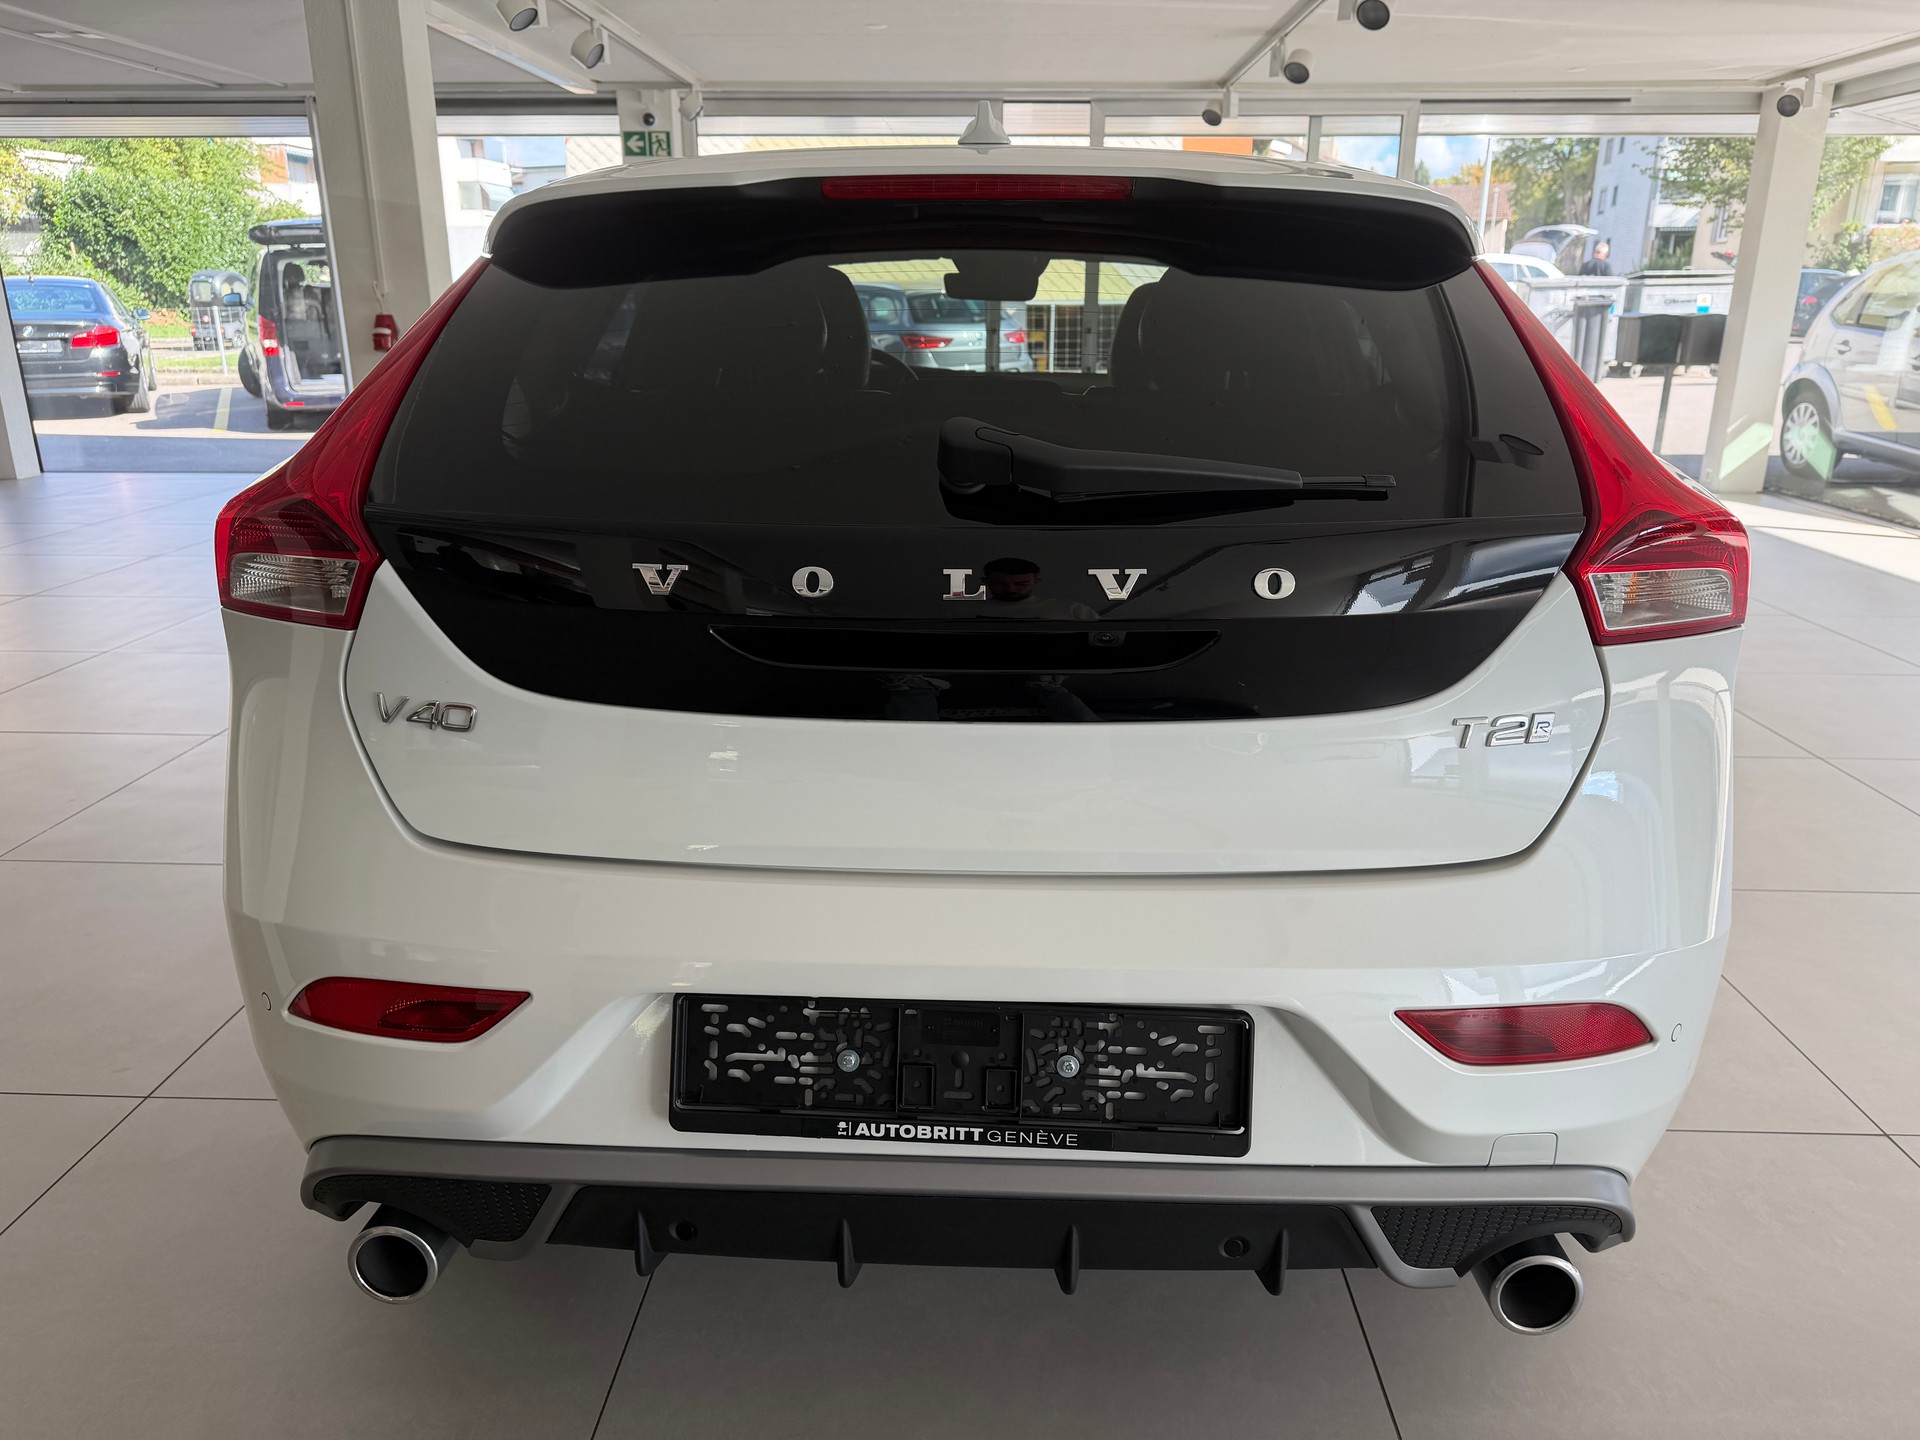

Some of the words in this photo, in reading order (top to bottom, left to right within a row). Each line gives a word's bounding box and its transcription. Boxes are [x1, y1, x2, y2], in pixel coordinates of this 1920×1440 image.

[631, 563, 1296, 601] VOLVO
[376, 692, 477, 732] V40
[1452, 714, 1528, 748] T2
[855, 1122, 983, 1142] AUTOBRITT
[987, 1130, 1079, 1147] GENÈVE
